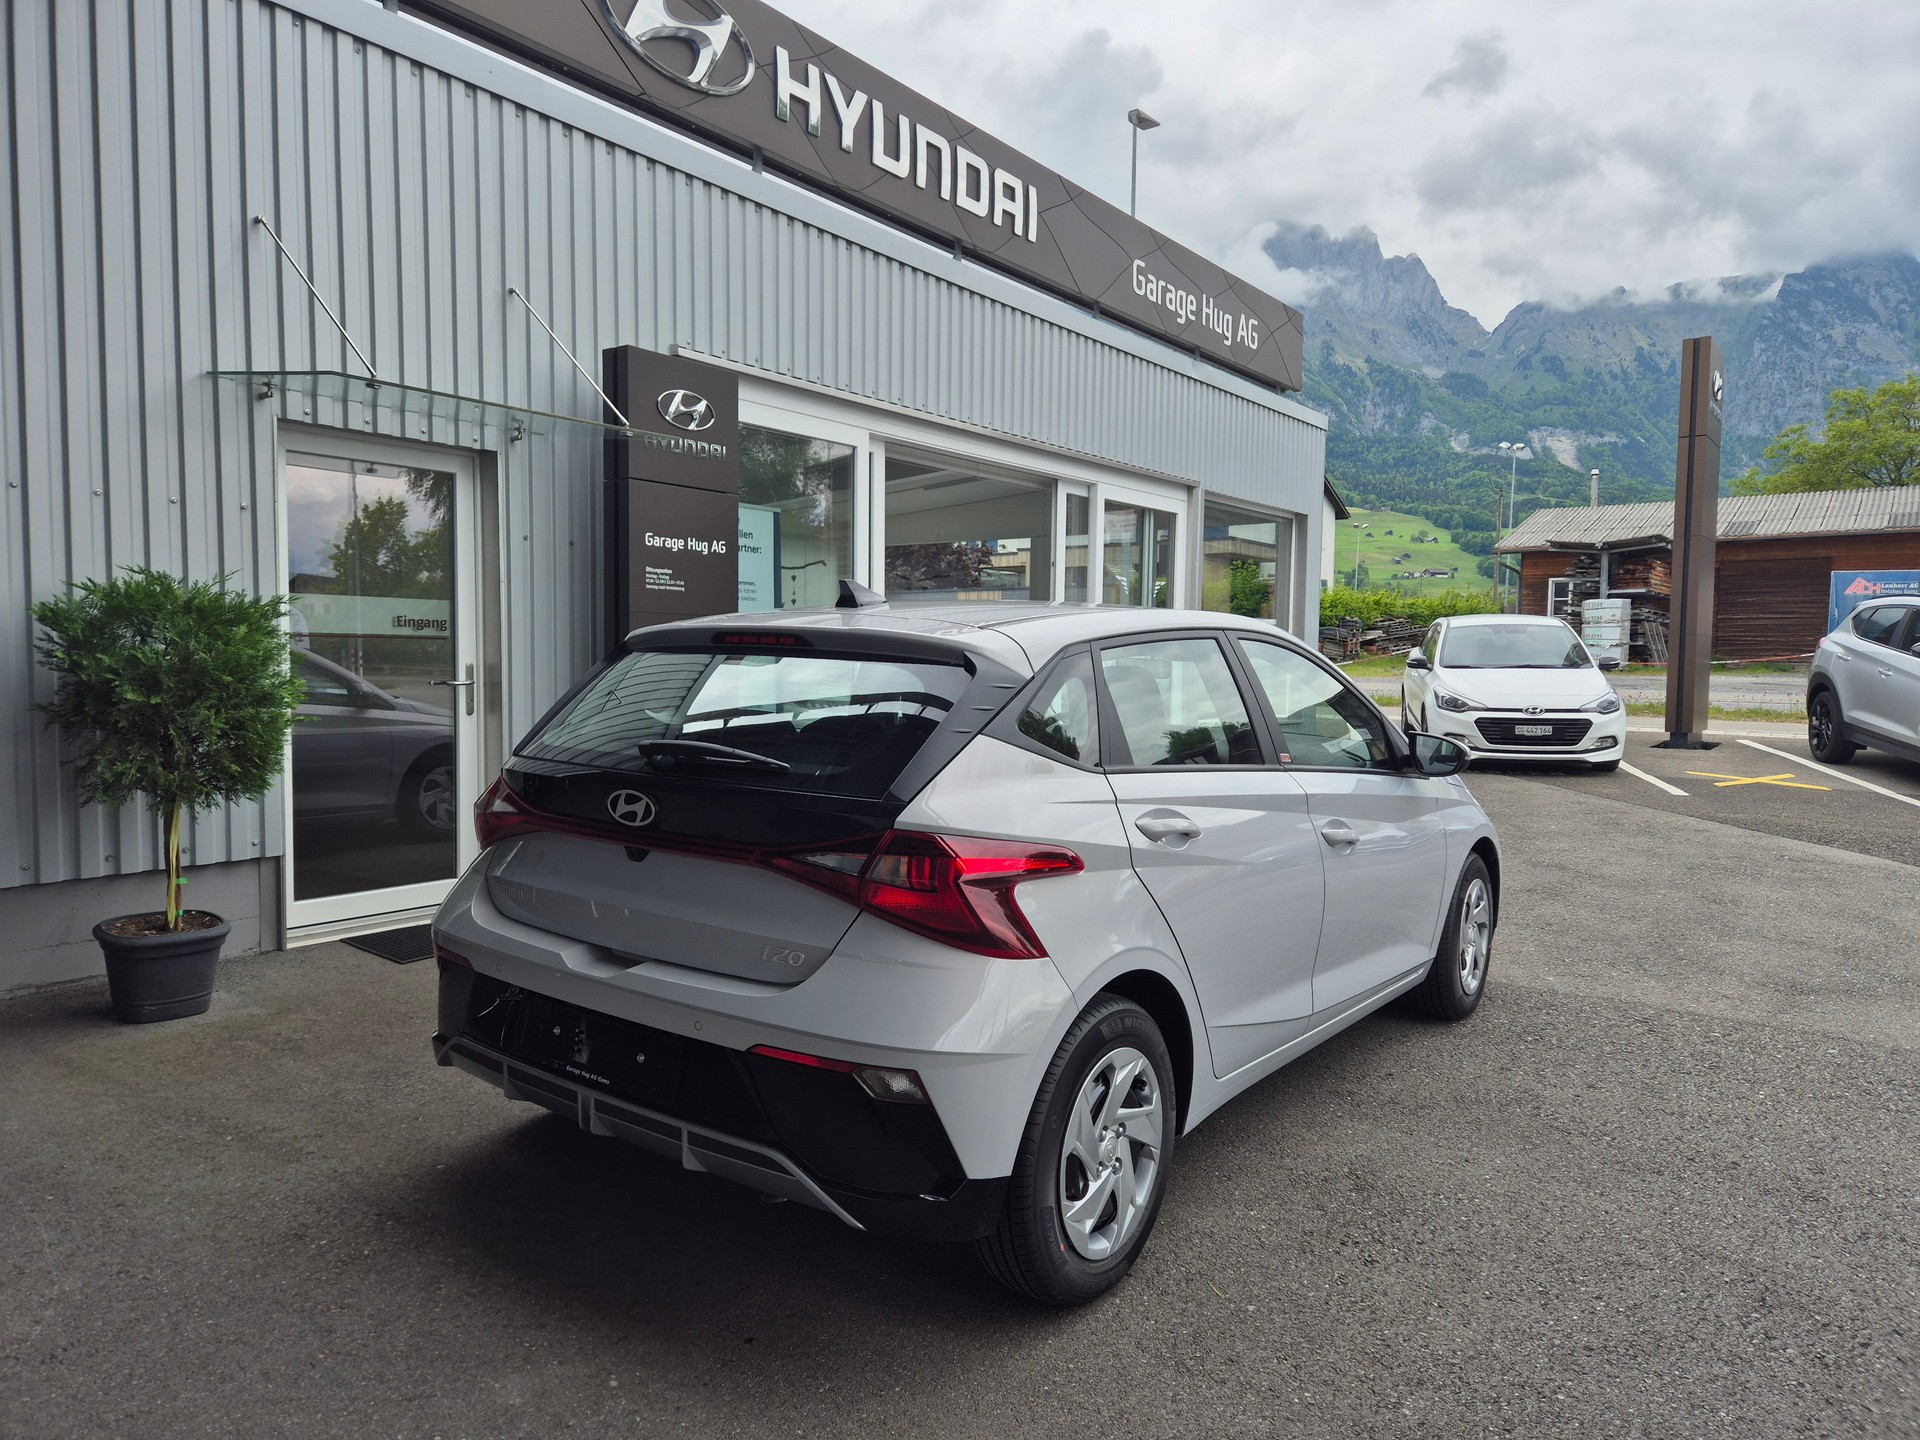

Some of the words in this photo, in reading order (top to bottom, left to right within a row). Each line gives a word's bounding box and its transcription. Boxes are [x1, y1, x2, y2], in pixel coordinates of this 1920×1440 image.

[776, 45, 1037, 243] HYUNDAI
[1132, 259, 1197, 325] Garage
[1202, 293, 1233, 346] Hug
[1236, 313, 1259, 350] AG
[644, 434, 727, 461] HYUNDAI
[645, 532, 685, 552] Garage
[687, 537, 709, 555] Hug
[711, 540, 726, 554] AG
[396, 614, 448, 632] Eingang
[1516, 726, 1525, 734] SG
[1526, 726, 1539, 734] 442
[566, 1064, 581, 1075] Garage
